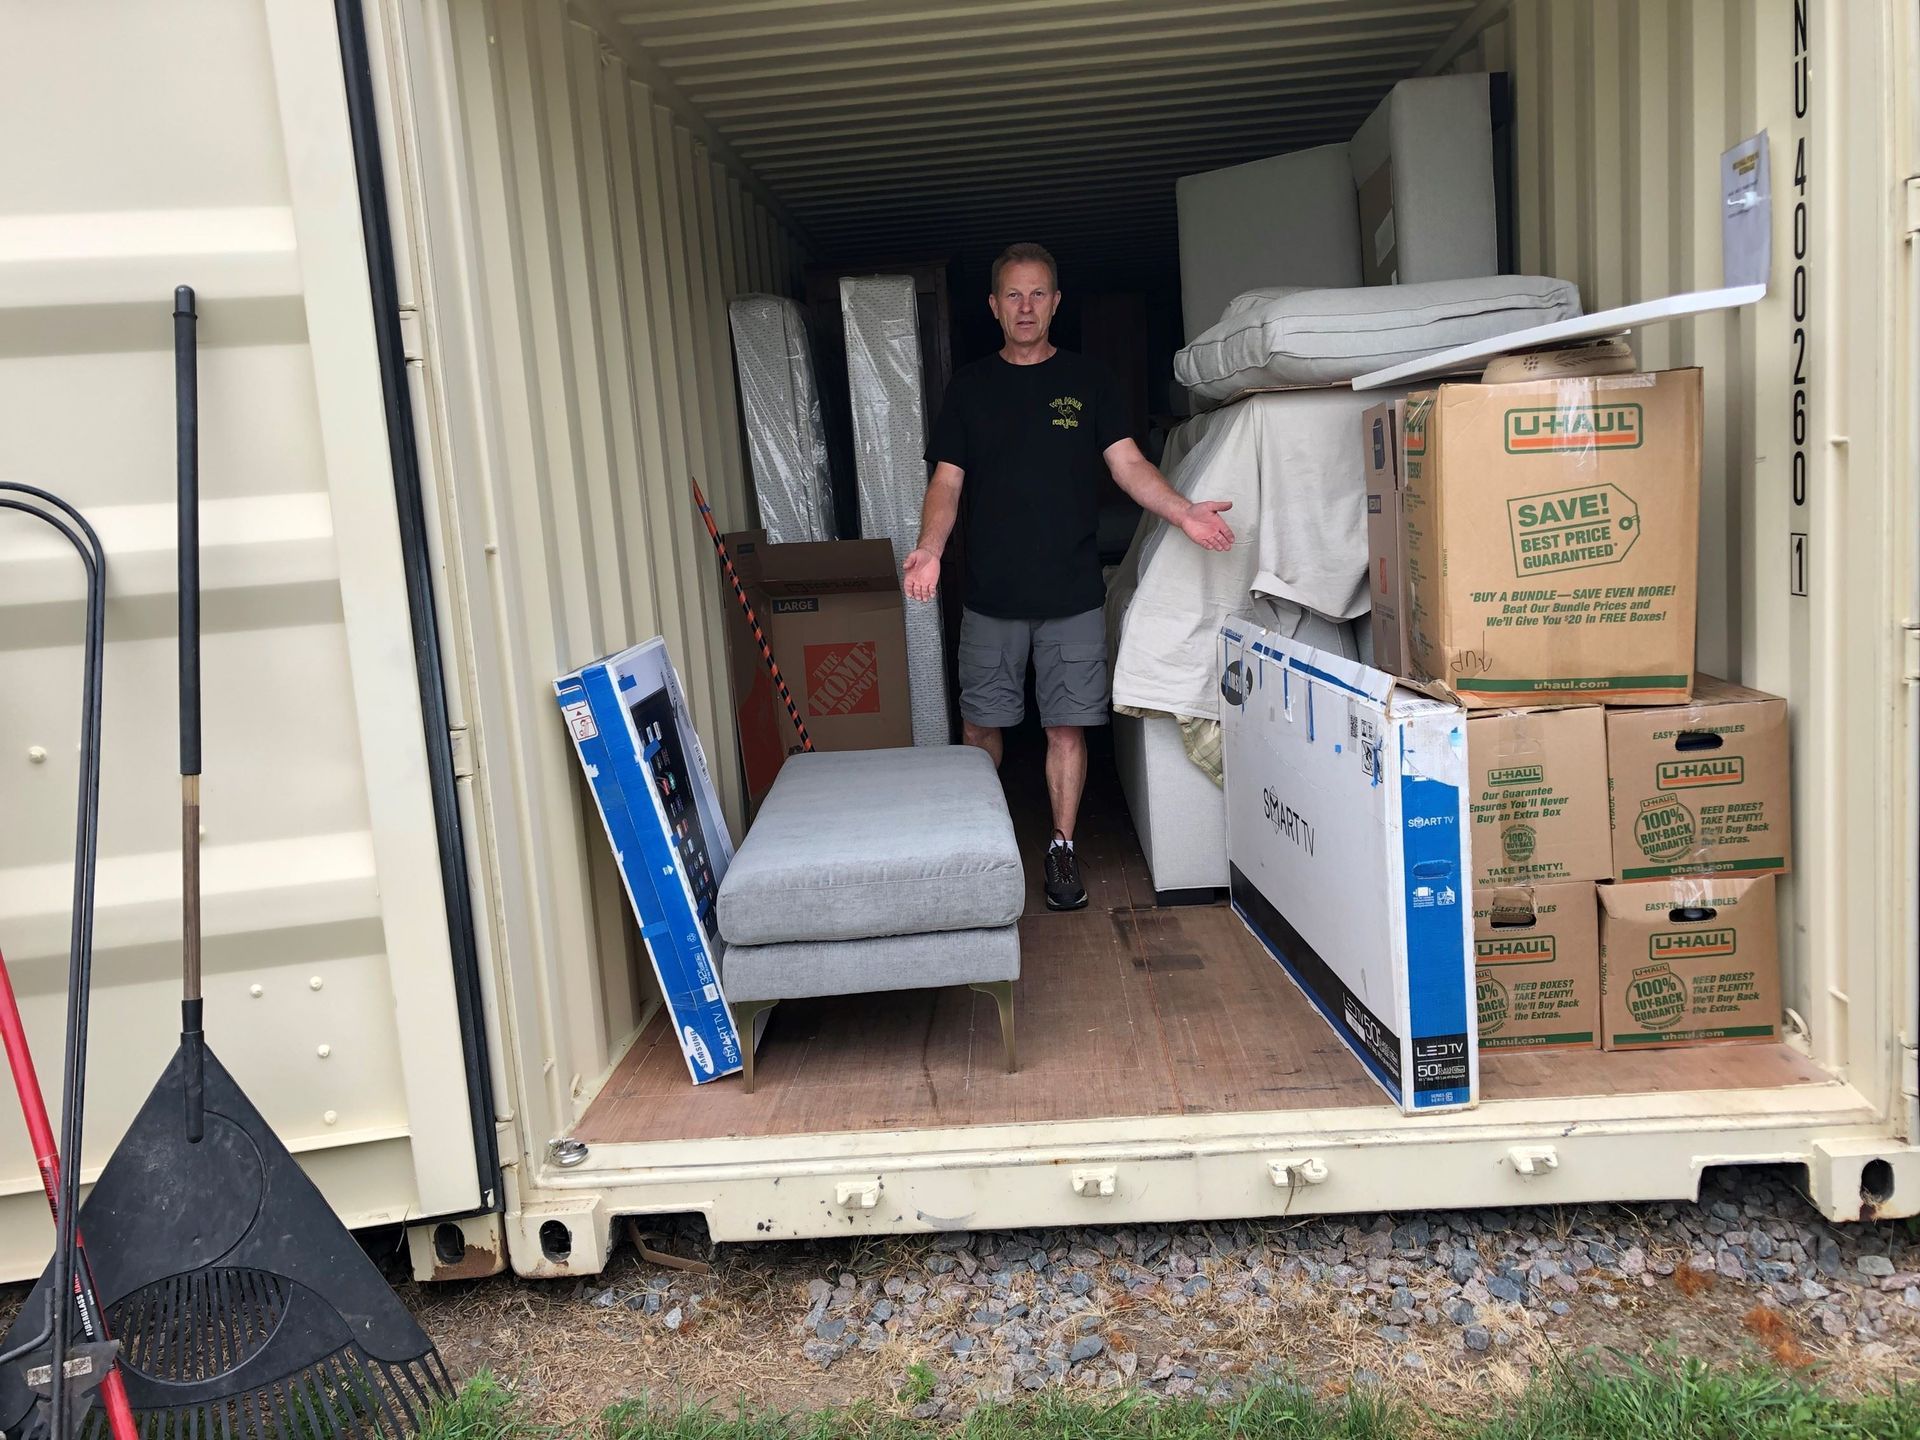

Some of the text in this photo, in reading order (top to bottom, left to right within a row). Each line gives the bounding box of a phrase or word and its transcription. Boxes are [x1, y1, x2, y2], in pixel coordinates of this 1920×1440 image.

[1794, 137, 1806, 506] 400260
[1514, 411, 1634, 436] U-HAUL
[1518, 492, 1609, 527] SAVE!
[1521, 526, 1611, 553] BEST PRICE
[1499, 592, 1508, 602] A
[1605, 587, 1634, 598] EVEN
[1638, 585, 1676, 597] MORE!
[778, 600, 814, 611] LARGE
[1502, 600, 1651, 614] Beat Our Bundle Prices and
[1486, 616, 1512, 626] We'll
[1516, 616, 1538, 626] Give
[1542, 615, 1561, 625] You
[1586, 614, 1596, 624] in
[1600, 613, 1626, 623] FREE
[1630, 612, 1666, 622] Boxes!
[813, 651, 842, 681] THE
[809, 641, 876, 716] HOME
[1534, 680, 1610, 690] uhaul.com
[836, 667, 878, 714] DEPOT
[1490, 768, 1540, 780] U-HAUL
[1662, 762, 1738, 779] U-HAUL
[1482, 788, 1553, 800] Our Guarantee
[1470, 797, 1568, 813] Ensures You'll Never
[1643, 795, 1674, 808] U-HAUL
[1700, 802, 1764, 815] NEED BOXES?
[1264, 785, 1314, 857] SMART TV
[1408, 816, 1454, 828] SMART TV
[1477, 808, 1561, 824] Buy an Extra Box
[1642, 806, 1684, 830] 100%
[1701, 812, 1764, 825] TAKE PLENTY!
[1640, 822, 1692, 845] BUY-BACK
[1726, 826, 1744, 834] Buy
[1746, 823, 1770, 832] Back
[1643, 834, 1694, 856] GUARANTEE
[1719, 836, 1750, 844] Extras.
[1488, 862, 1563, 876] TAKE PLENTY!
[1478, 940, 1550, 956] U-HAUL
[1655, 934, 1730, 950] U-HAUL
[1636, 966, 1668, 976] U-HAUL
[1692, 972, 1754, 984] NEED BOXES?
[1514, 980, 1574, 992] NEED BOXES?
[1634, 976, 1676, 998] 100%
[1694, 982, 1754, 994] TAKE PLENTY!
[1515, 990, 1574, 1000] TAKE PLENTY!
[1632, 992, 1684, 1011] BUY-BACK
[1717, 994, 1734, 1003] Buy
[1737, 992, 1760, 1001] Back
[1538, 1001, 1555, 1010] Buy
[1557, 999, 1580, 1008] Back
[1693, 1006, 1707, 1014] the
[1532, 1011, 1560, 1020] Extras.
[1635, 1004, 1686, 1022] GUARANTEE
[1486, 1036, 1546, 1047] uhaul.com
[1662, 1030, 1724, 1041] uhaul.com
[690, 1030, 708, 1069] SAMSUNG
[719, 1026, 738, 1064] SMART
[1416, 1043, 1464, 1057] LED TV
[76, 1294, 94, 1337] FIBERGLASS
